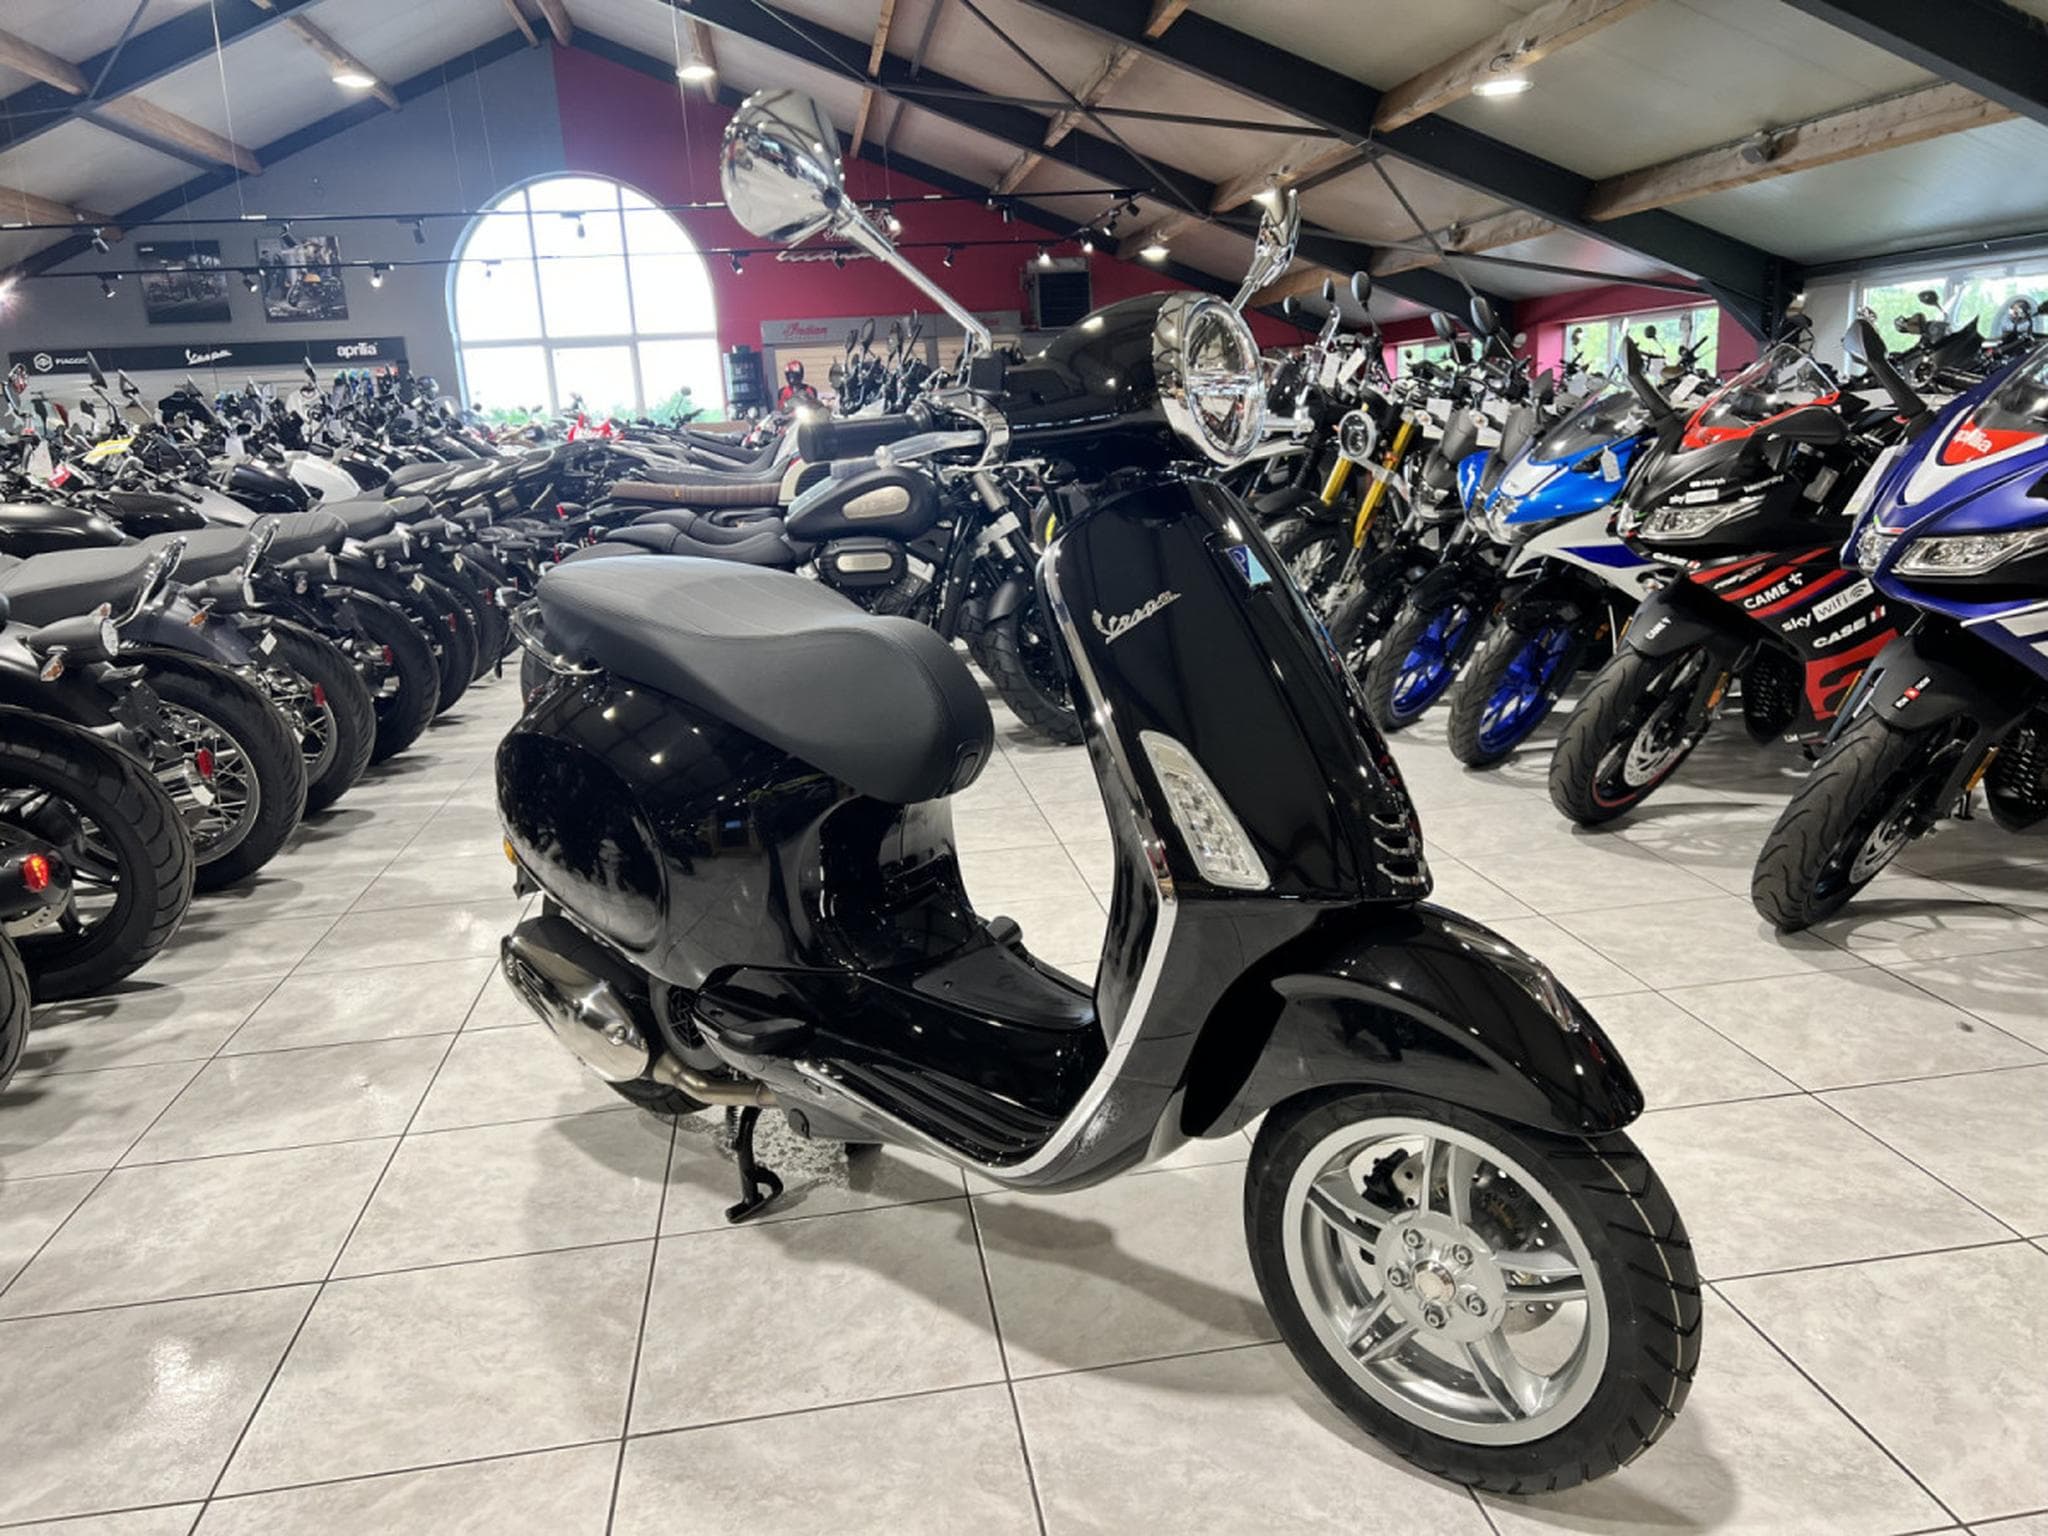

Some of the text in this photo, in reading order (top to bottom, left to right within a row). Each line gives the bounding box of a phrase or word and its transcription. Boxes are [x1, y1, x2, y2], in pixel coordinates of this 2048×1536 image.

[185, 348, 232, 365] Vespa
[336, 342, 378, 359] aprilia
[1743, 581, 1790, 609] CAME
[1092, 590, 1182, 645] Vespa
[1781, 613, 1812, 632] sky
[1812, 616, 1867, 648] CASE
